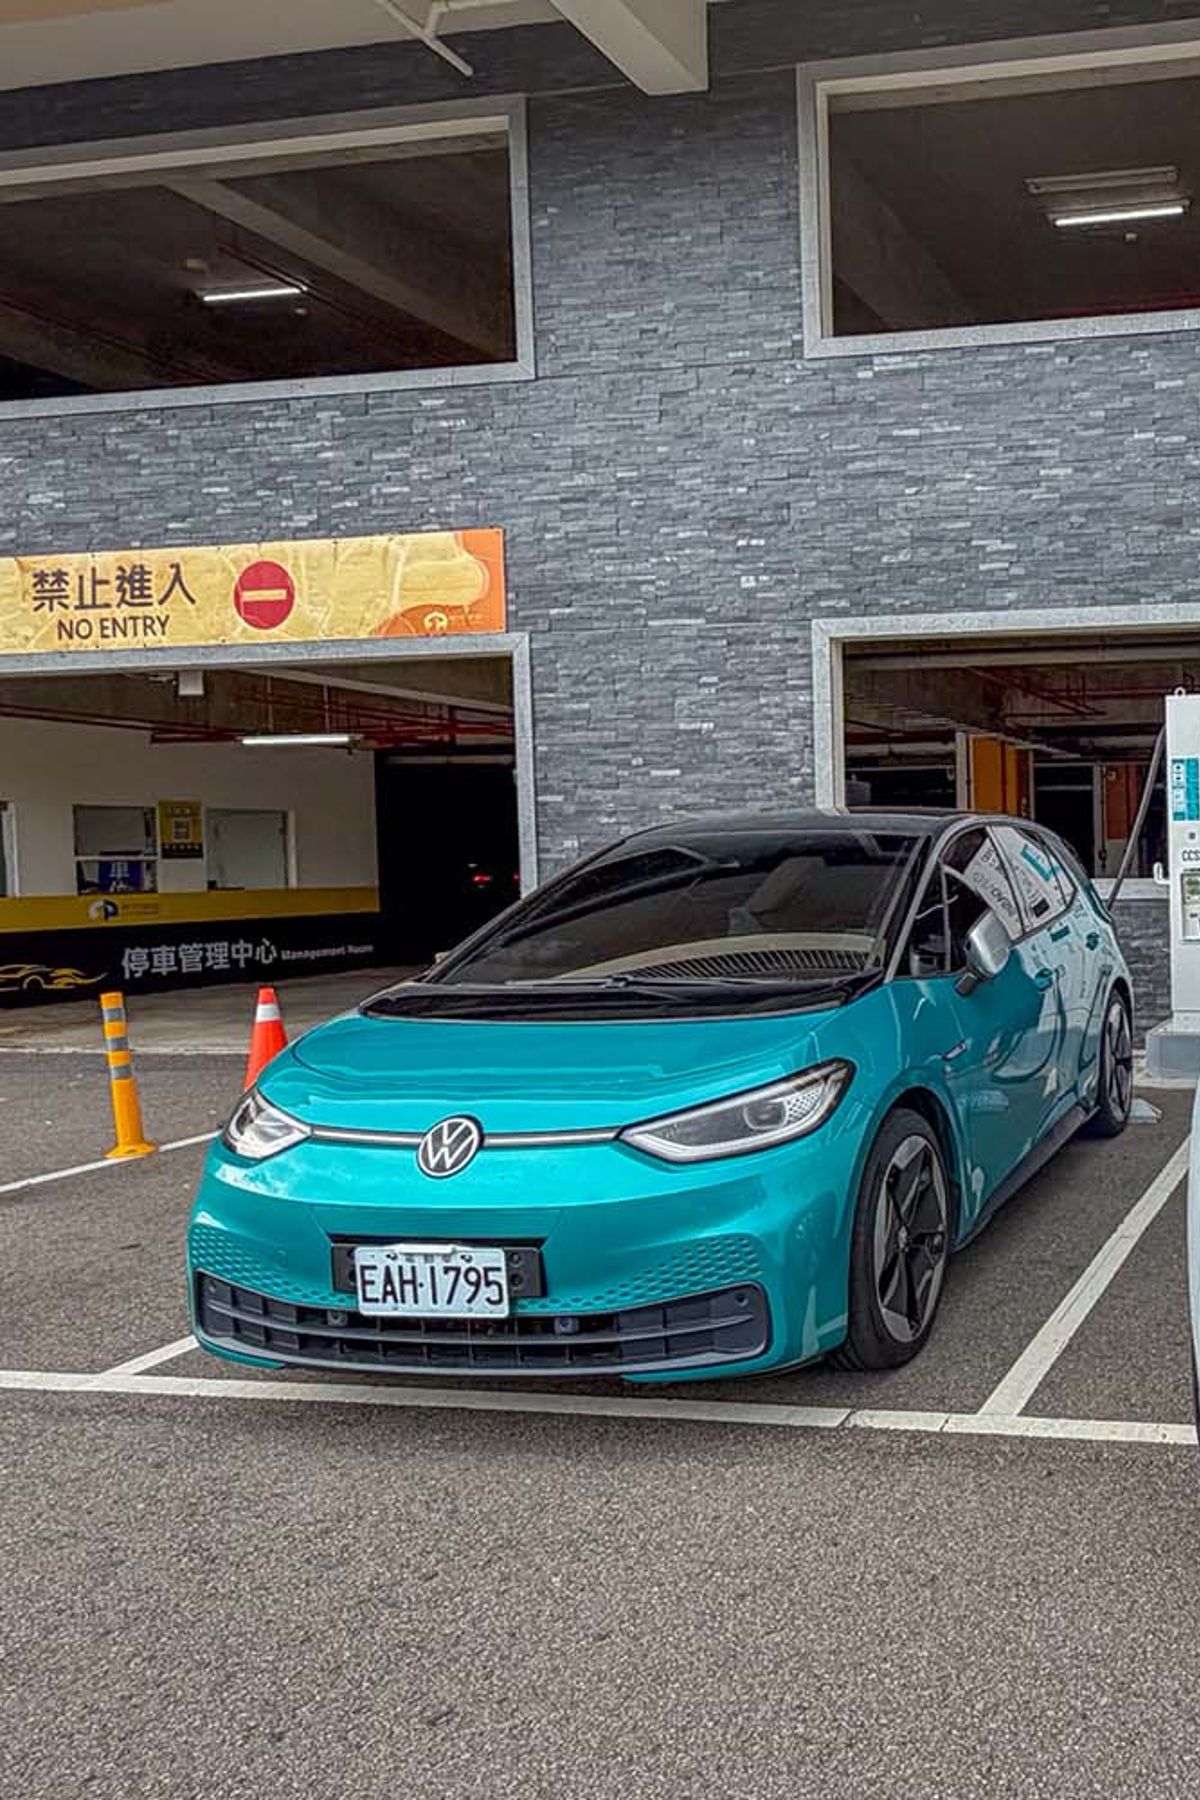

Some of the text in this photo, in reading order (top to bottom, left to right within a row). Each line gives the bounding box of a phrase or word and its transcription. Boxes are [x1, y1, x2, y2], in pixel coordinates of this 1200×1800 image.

[33, 562, 196, 612] 禁止進入
[57, 615, 170, 641] NO ENTRY
[121, 938, 278, 980] 停車管理中心
